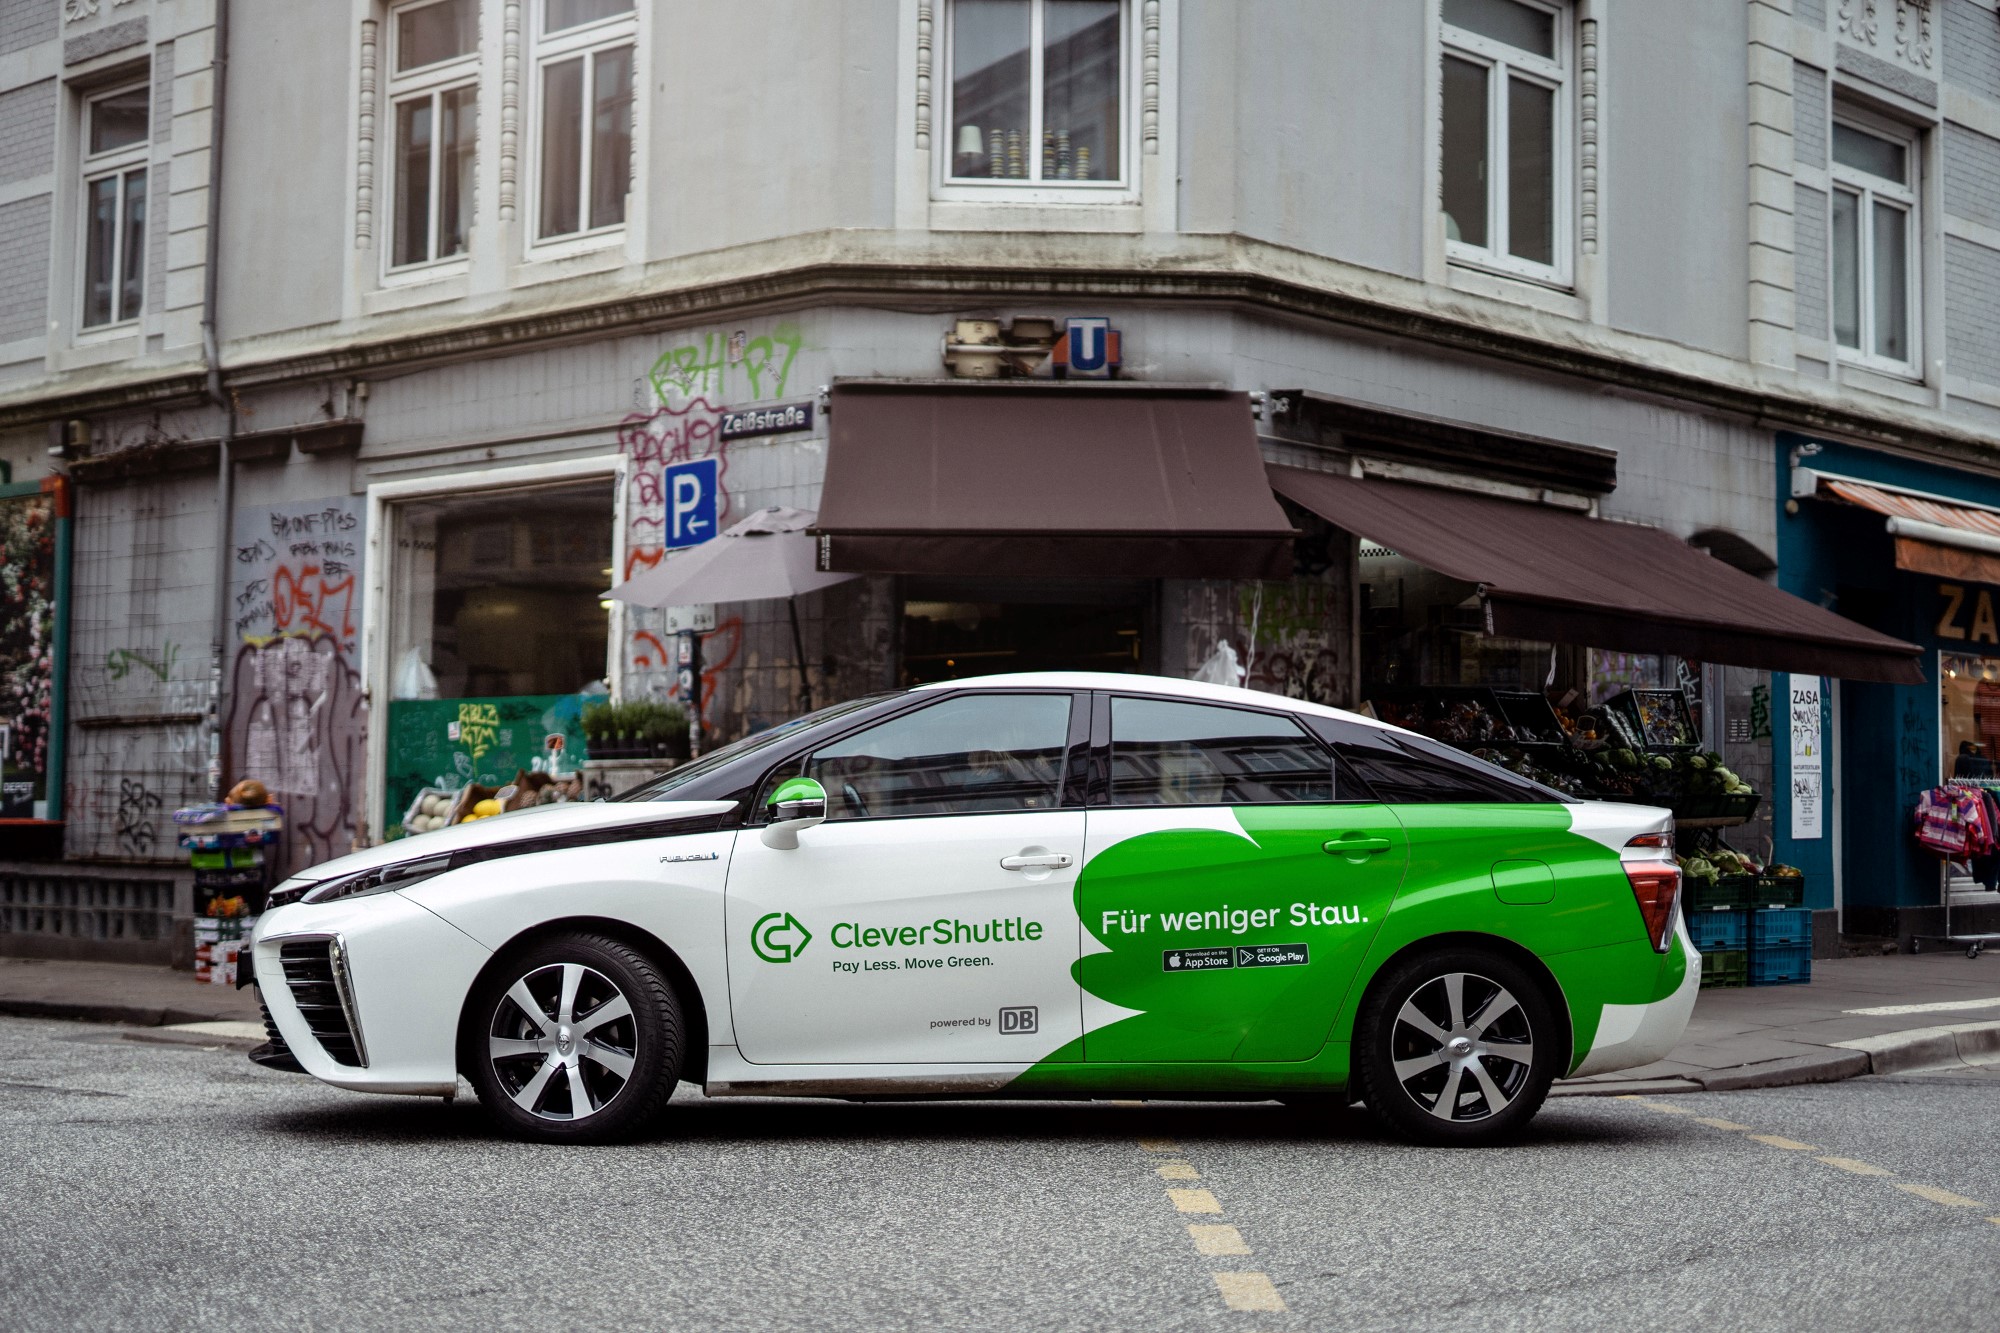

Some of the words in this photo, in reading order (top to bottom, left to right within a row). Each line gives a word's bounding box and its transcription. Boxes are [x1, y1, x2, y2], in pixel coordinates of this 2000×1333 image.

[722, 405, 806, 435] Zeißstraße
[672, 472, 701, 540] P
[1792, 689, 1820, 705] ZASA
[1101, 910, 1151, 935] Für
[1160, 904, 1281, 935] weniger
[1289, 902, 1369, 926] Stau.
[830, 916, 1044, 949] CleverShuttle
[832, 961, 860, 974] Pay
[864, 959, 901, 971] Less.
[904, 957, 944, 969] Move
[947, 955, 994, 967] Green.
[1184, 958, 1204, 968] App
[1204, 956, 1229, 966] Store
[1257, 953, 1287, 964] Google
[1287, 952, 1305, 962] Play
[930, 1017, 976, 1030] powered
[978, 1016, 992, 1027] by
[1002, 1009, 1035, 1031] DB
